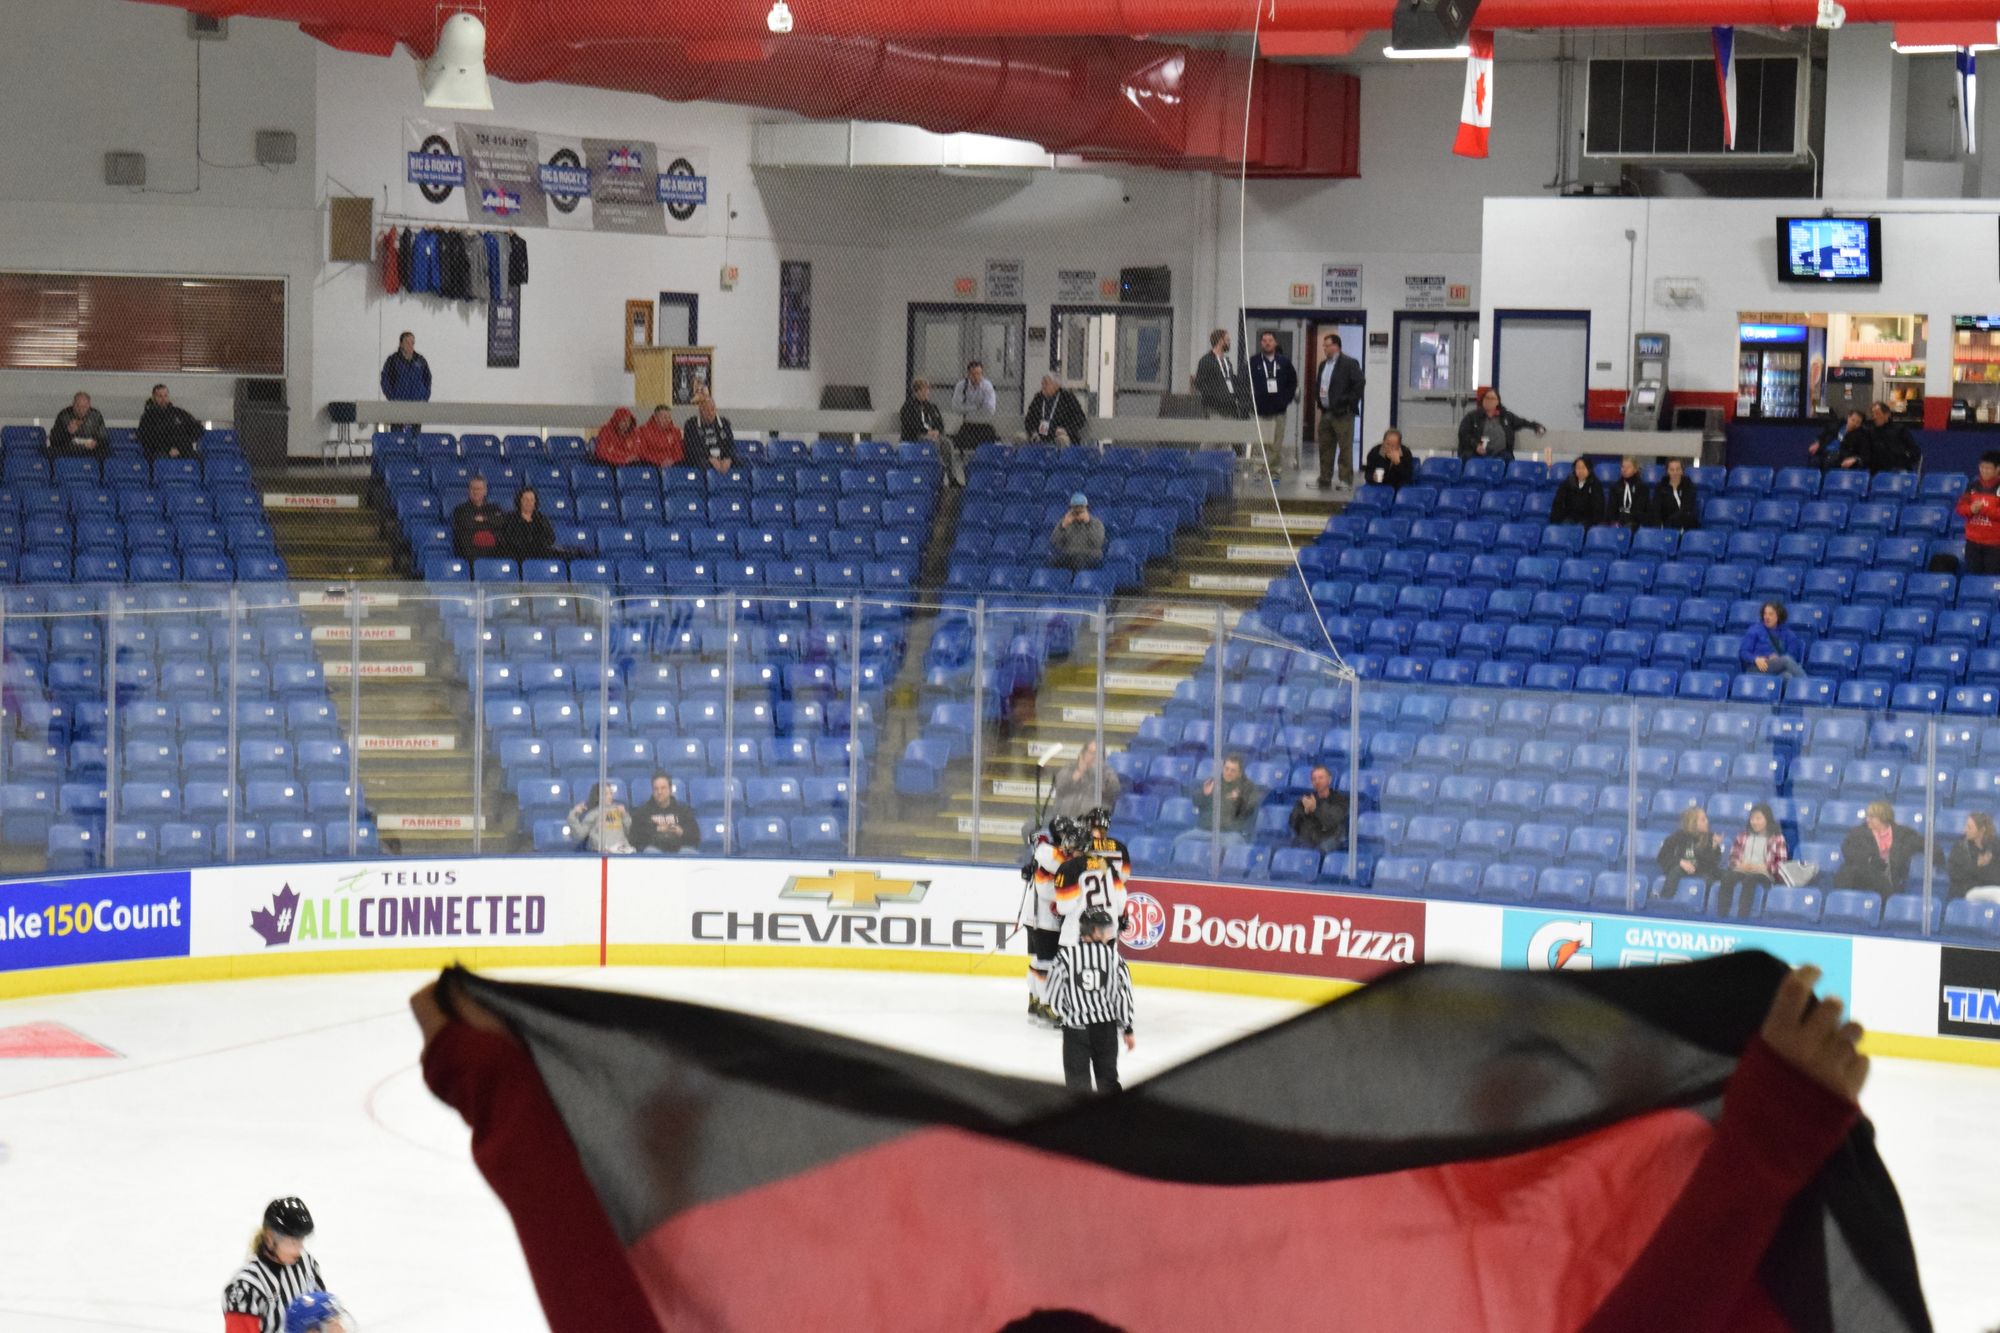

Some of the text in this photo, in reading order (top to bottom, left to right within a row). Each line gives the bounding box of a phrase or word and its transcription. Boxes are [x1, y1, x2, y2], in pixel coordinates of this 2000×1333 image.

[1293, 285, 1309, 298] EXIT
[1450, 286, 1466, 299] EXIT
[285, 497, 337, 505] FARMERS
[325, 629, 396, 639] INSUANCE
[365, 738, 440, 748] INSURANCE
[401, 818, 461, 827] FARMERS
[381, 870, 457, 885] TELUS
[1084, 875, 1112, 908] 21
[692, 911, 1018, 950] CHEVROLET
[1169, 902, 1416, 965] Boston Pizza
[1625, 927, 1736, 954] GATORADE
[1081, 968, 1102, 991] 91
